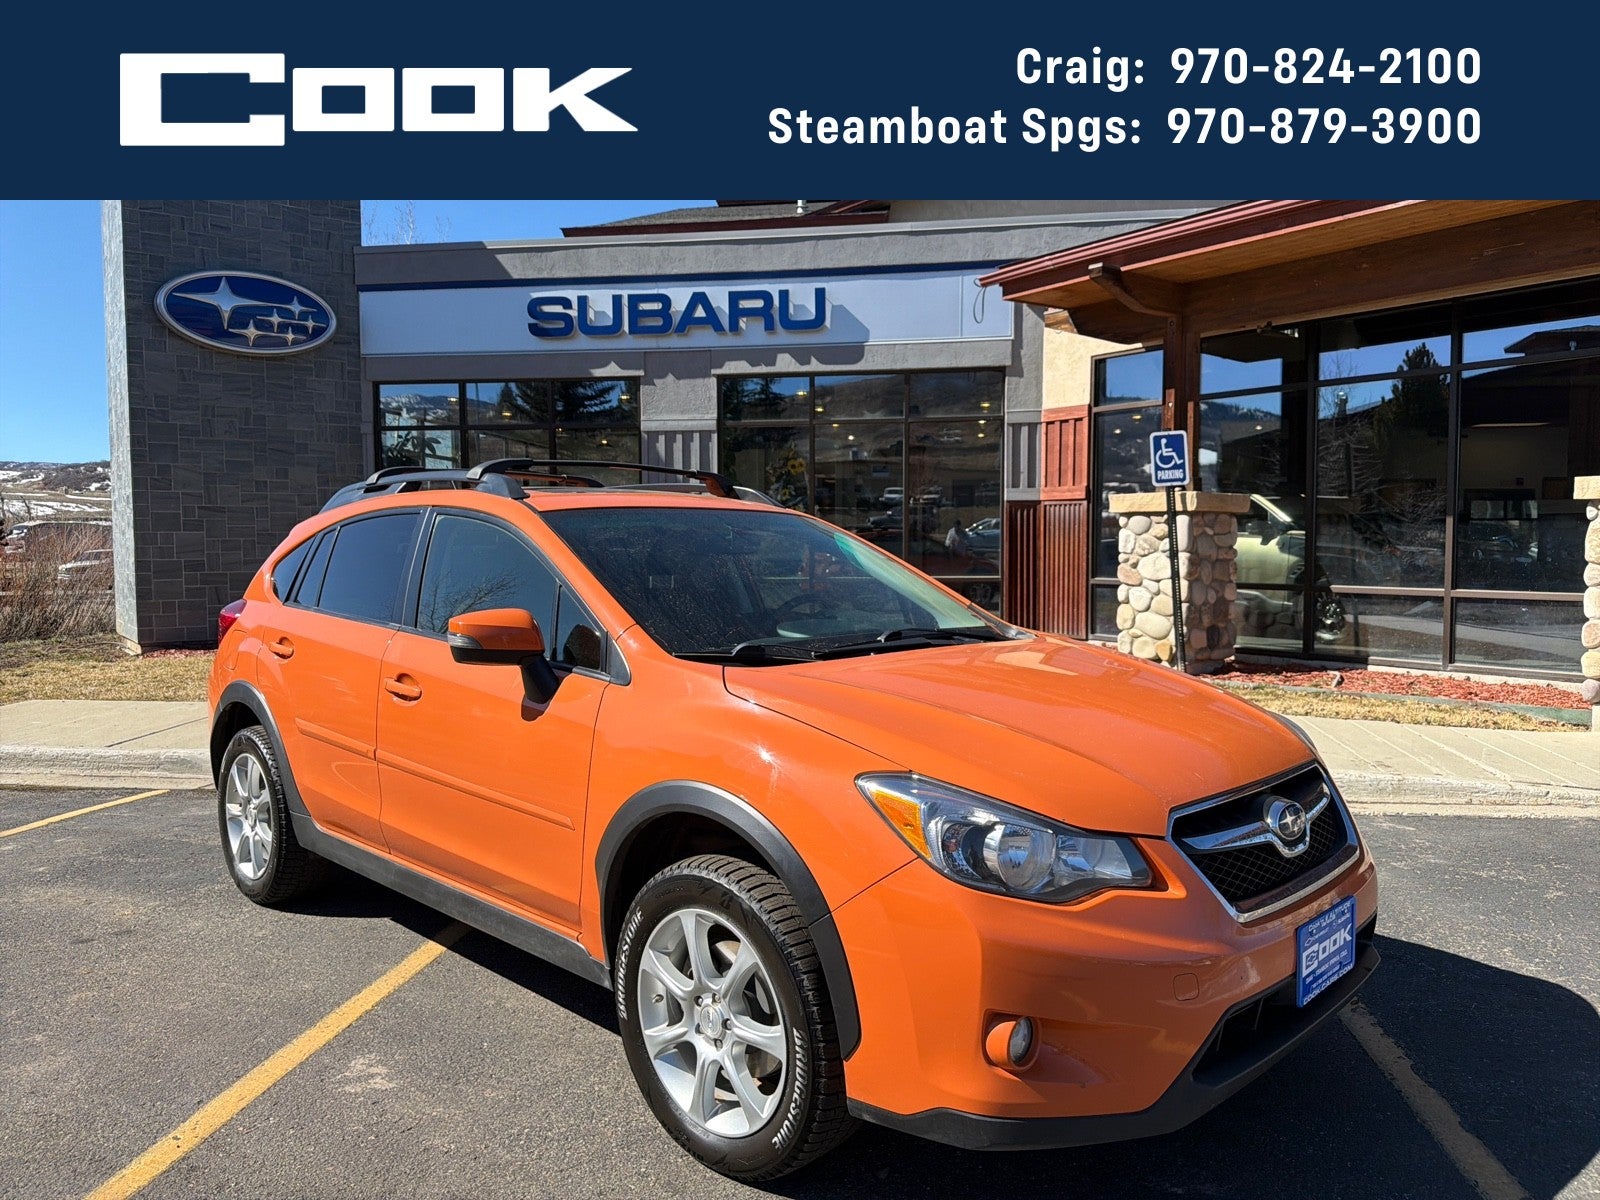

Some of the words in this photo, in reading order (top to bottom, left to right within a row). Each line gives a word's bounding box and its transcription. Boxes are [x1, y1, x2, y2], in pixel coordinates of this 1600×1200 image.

[527, 287, 826, 339] SUBARU
[1157, 469, 1184, 480] PARKING
[615, 907, 644, 1020] BRIDGESTONE
[771, 1027, 808, 1150] BRIDGESTONE
